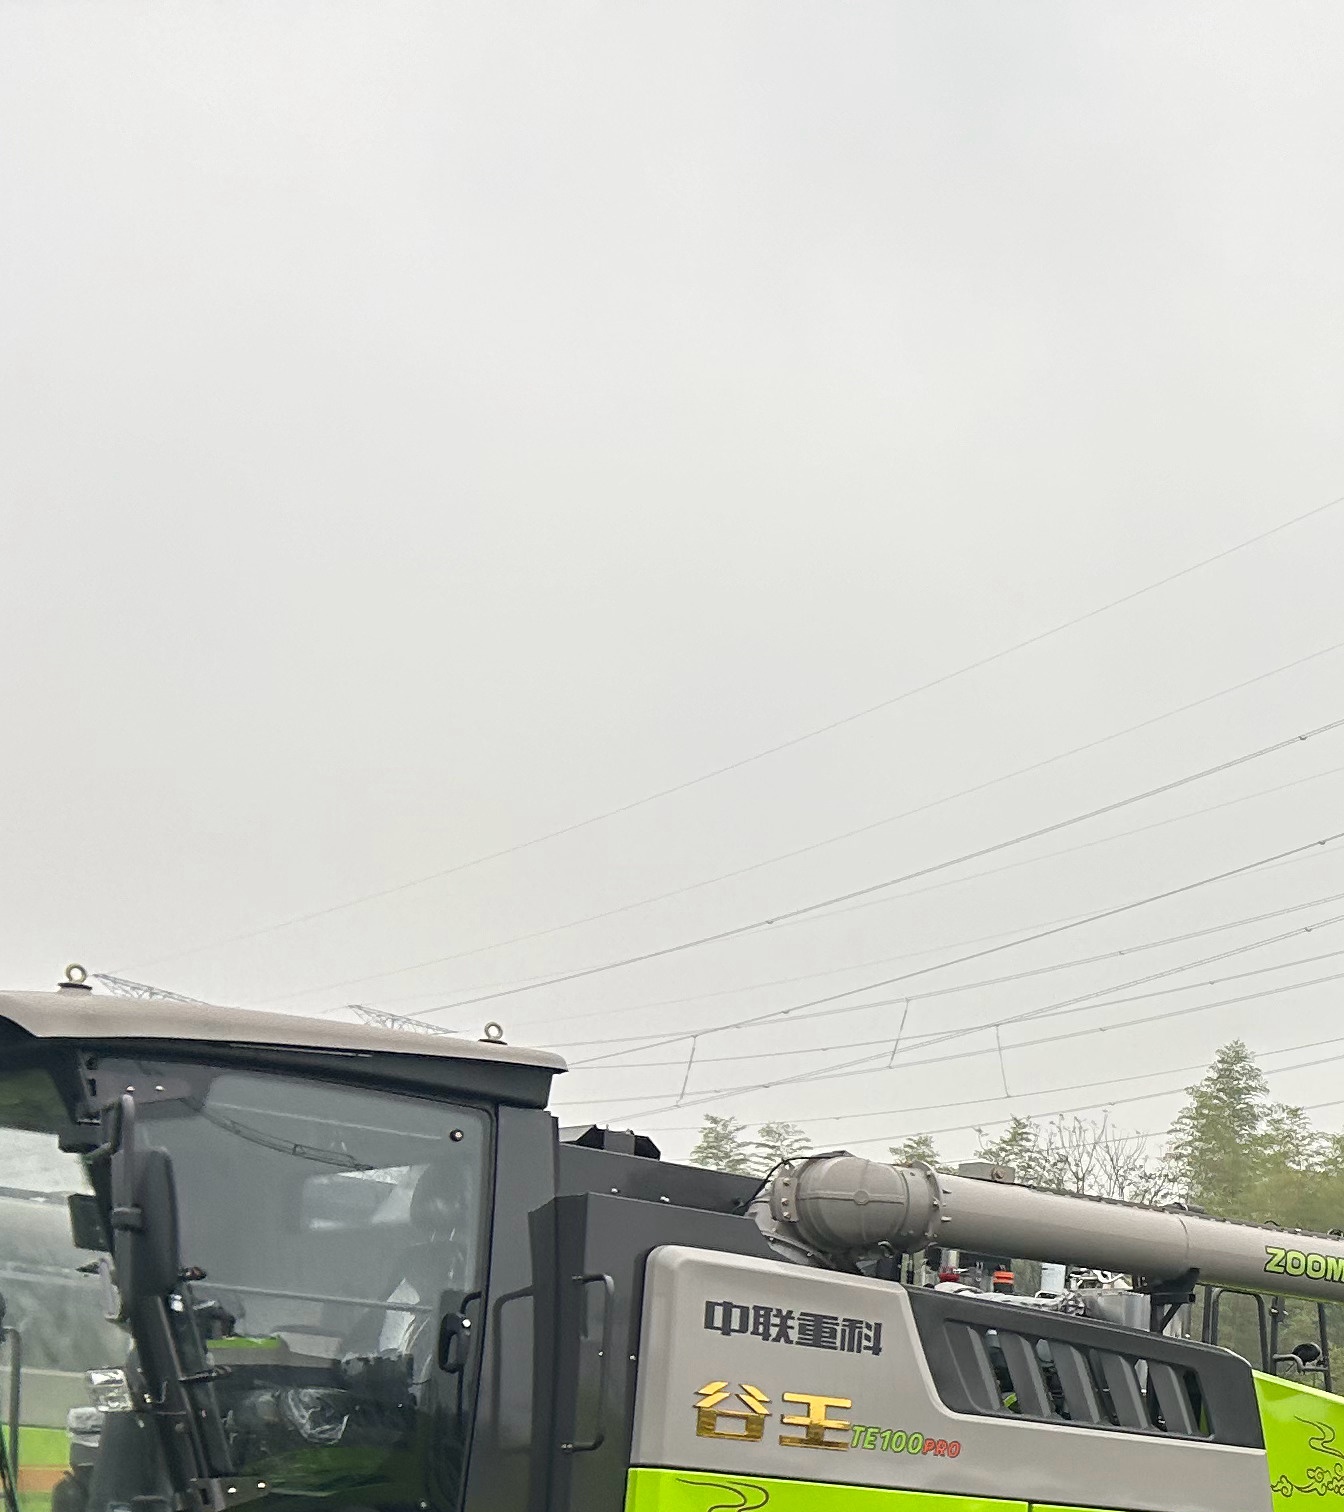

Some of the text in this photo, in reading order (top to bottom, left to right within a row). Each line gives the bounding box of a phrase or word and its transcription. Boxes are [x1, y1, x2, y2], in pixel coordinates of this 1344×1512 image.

[704, 1300, 882, 1355] 中联重科
[693, 1381, 851, 1451] 谷王
